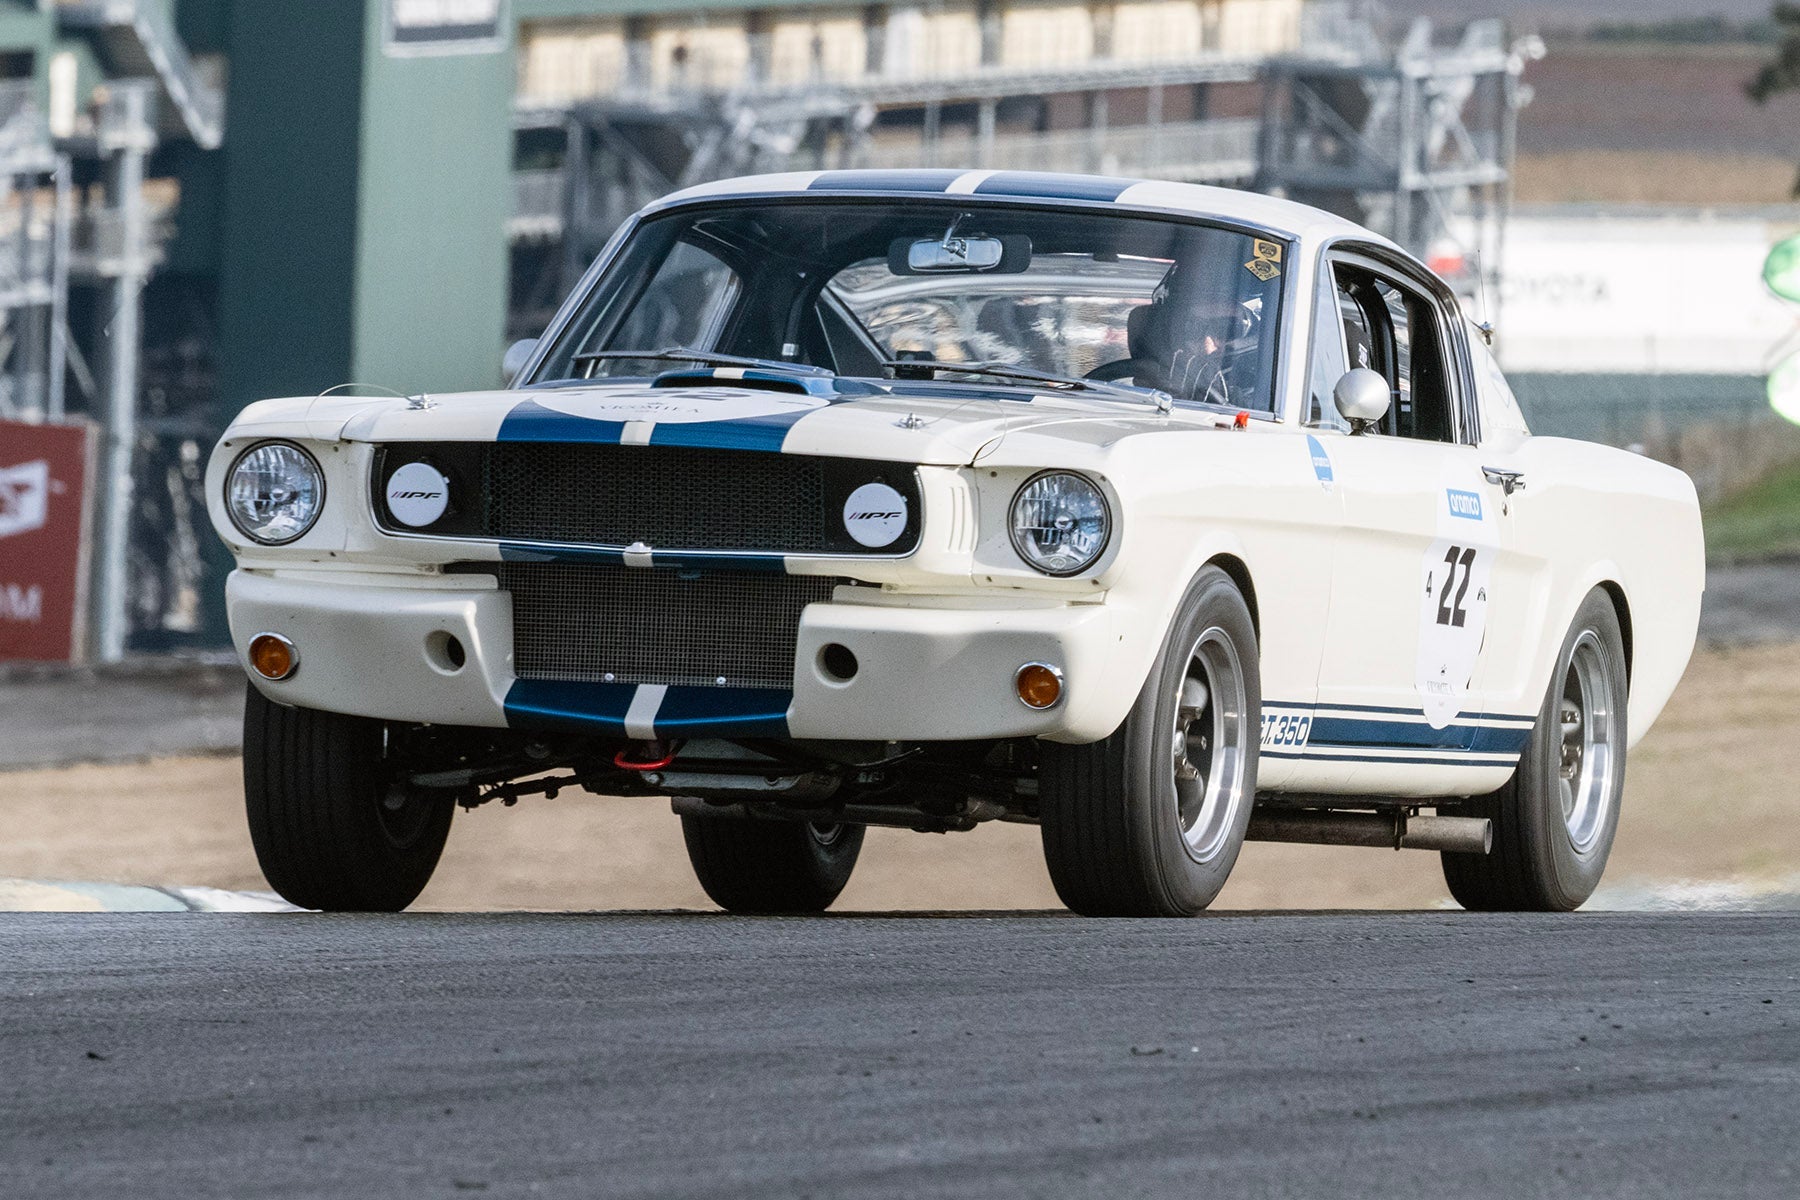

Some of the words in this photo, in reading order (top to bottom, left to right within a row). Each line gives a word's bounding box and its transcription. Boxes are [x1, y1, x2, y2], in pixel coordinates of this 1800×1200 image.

[1498, 272, 1610, 302] OYOTA
[400, 491, 442, 499] IPF
[1450, 493, 1480, 516] aramco
[858, 511, 902, 519] IPF
[1426, 571, 1432, 598] 4
[1436, 545, 1476, 627] 22
